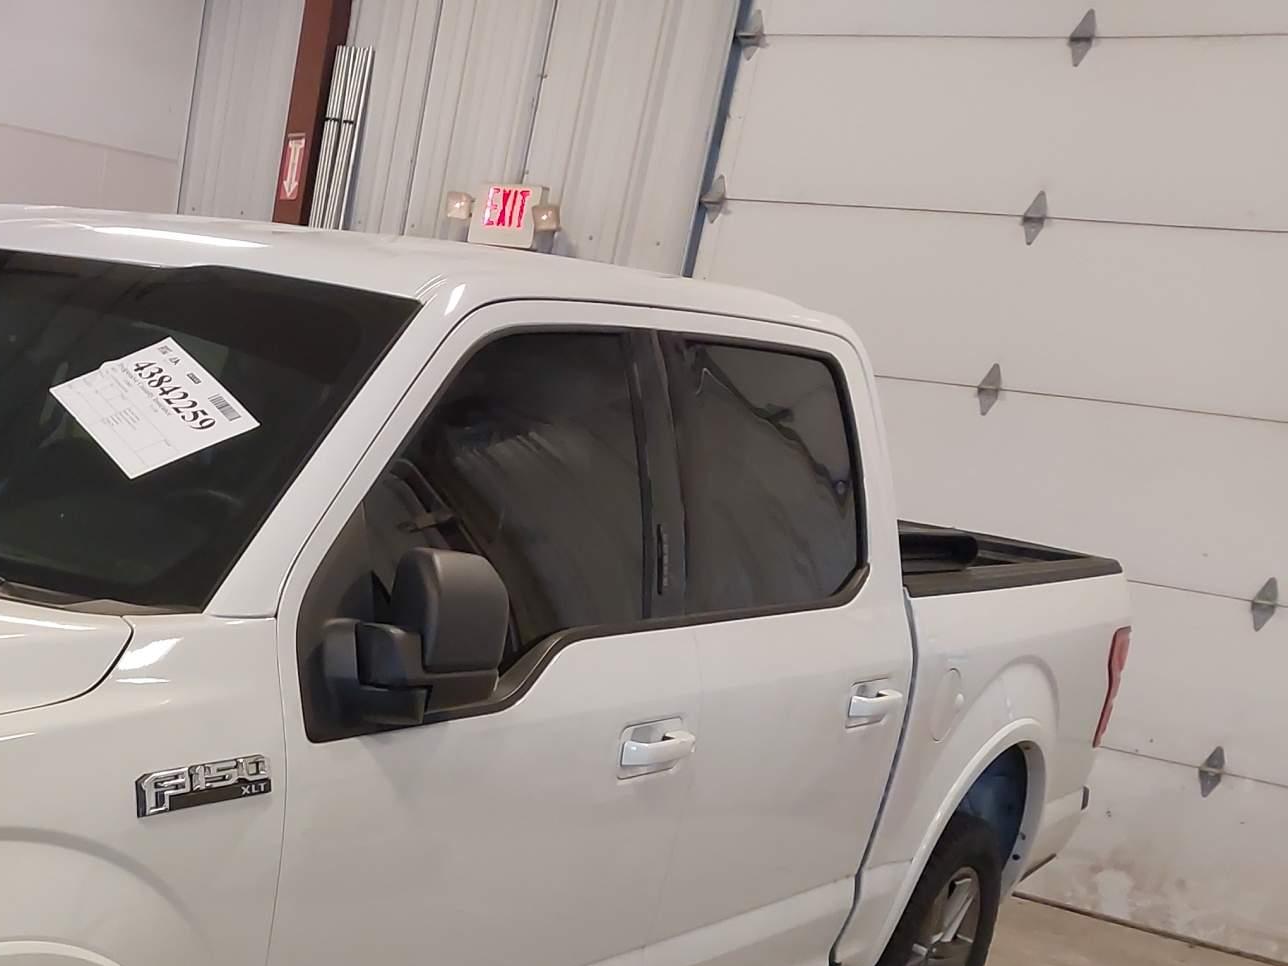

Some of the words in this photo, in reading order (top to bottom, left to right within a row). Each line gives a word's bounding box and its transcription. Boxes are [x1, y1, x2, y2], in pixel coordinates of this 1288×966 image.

[483, 187, 531, 228] EXIT
[133, 361, 216, 431] 43842259
[240, 783, 267, 796] XLT
